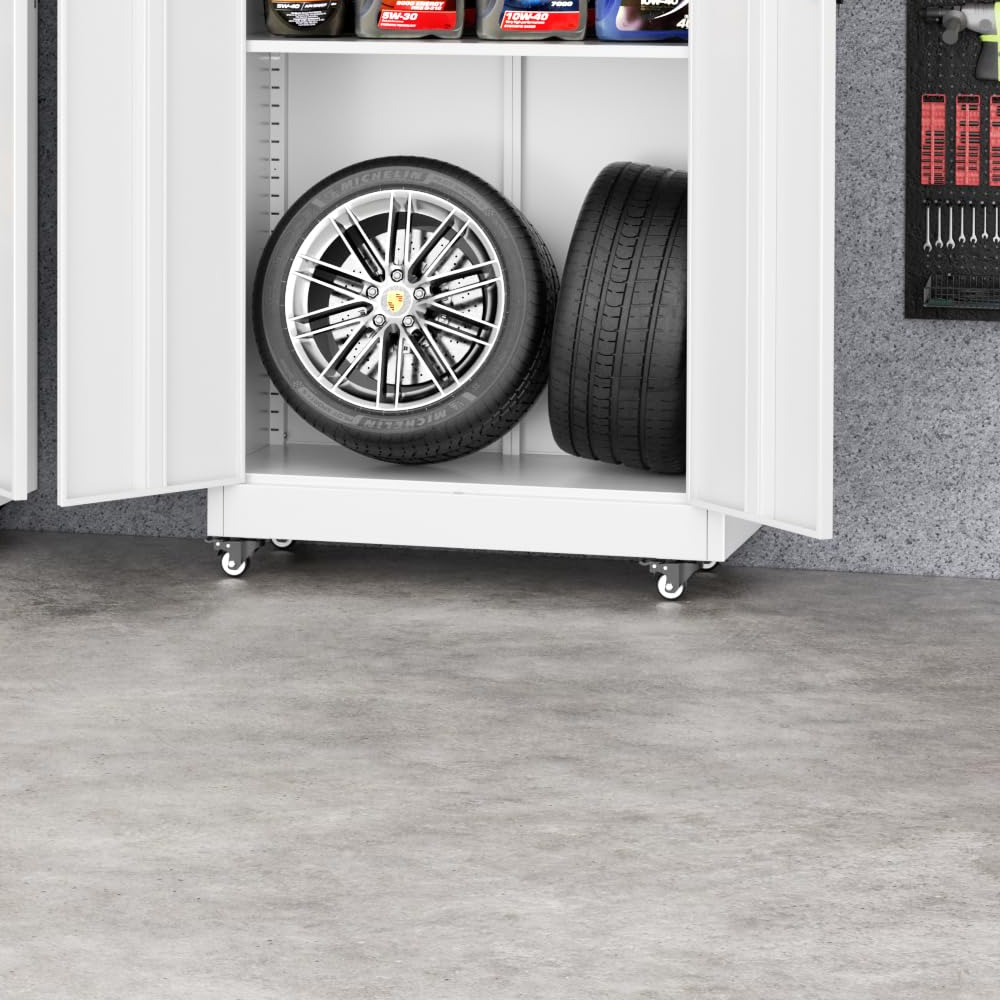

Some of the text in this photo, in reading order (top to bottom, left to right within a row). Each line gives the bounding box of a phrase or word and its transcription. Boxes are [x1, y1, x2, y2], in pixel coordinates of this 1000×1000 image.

[381, 12, 418, 21] 5W-30
[505, 12, 550, 21] 10W-40
[340, 170, 424, 192] MICHELIN
[363, 409, 448, 430] MICHELIN
